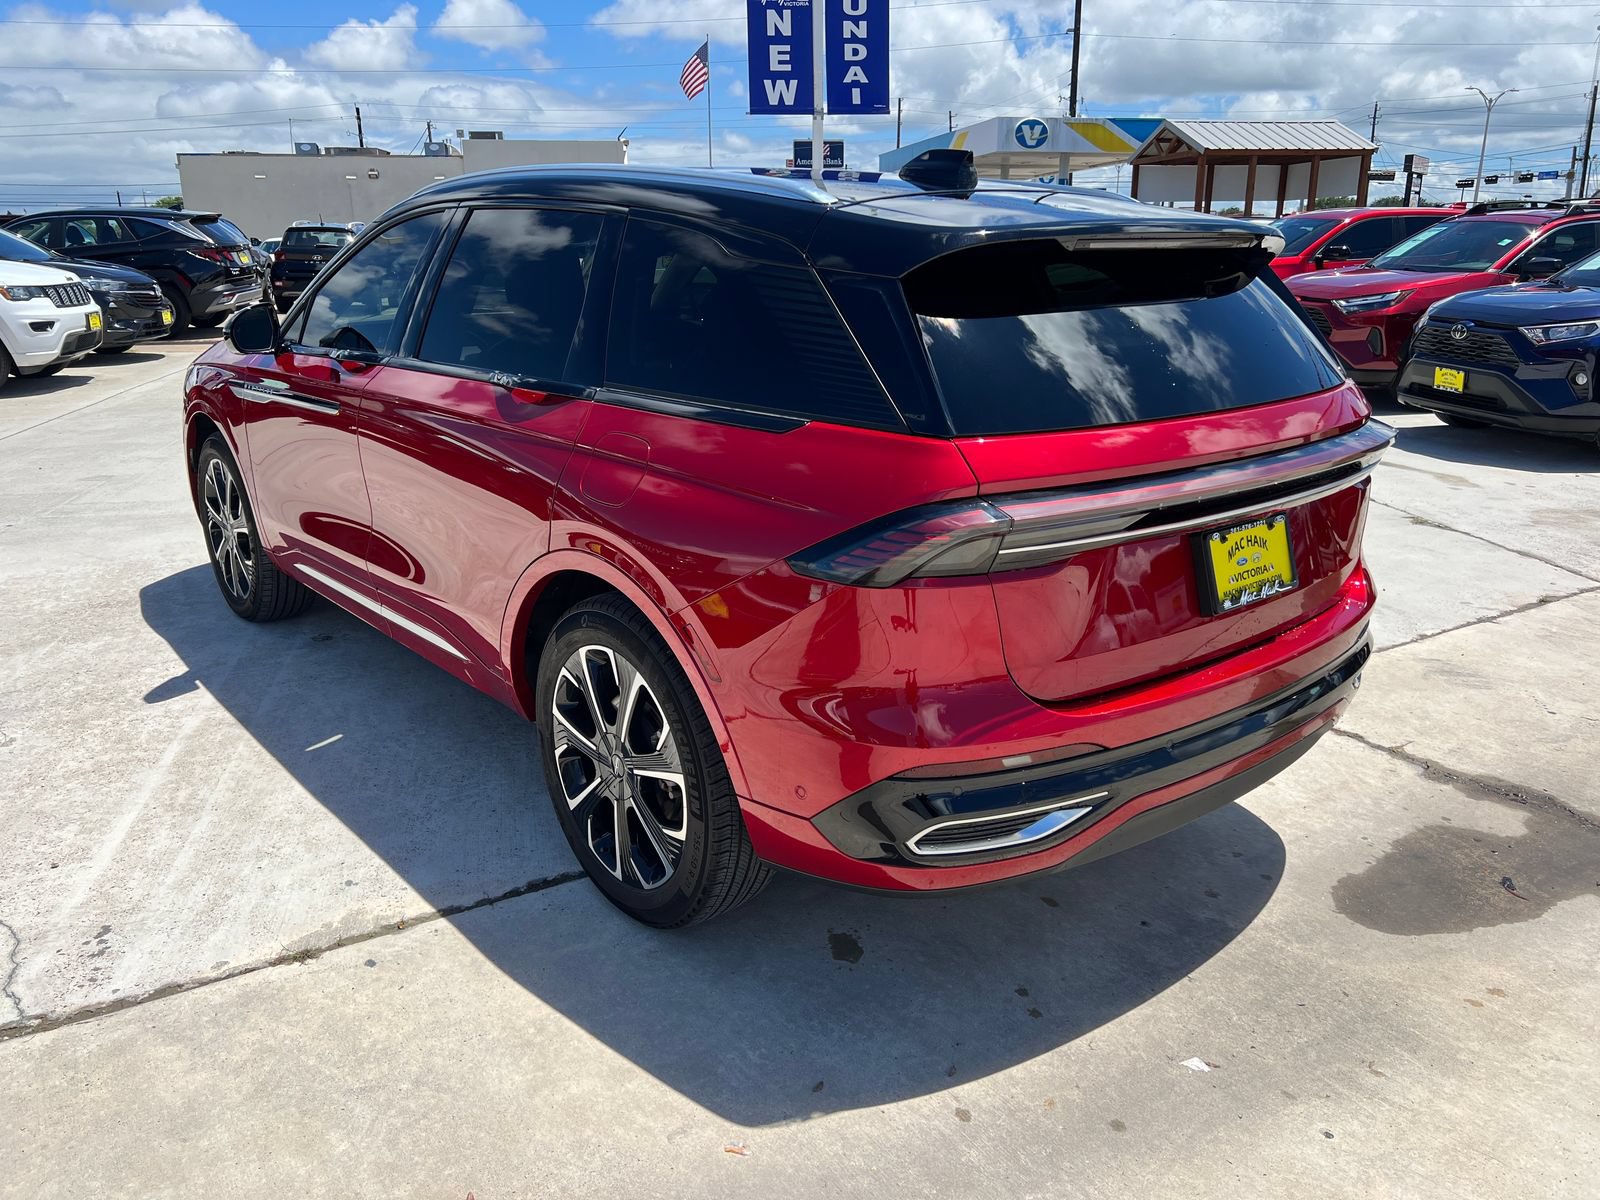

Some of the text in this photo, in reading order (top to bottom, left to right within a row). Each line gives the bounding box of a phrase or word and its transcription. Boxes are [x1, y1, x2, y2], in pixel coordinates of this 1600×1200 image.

[763, 9, 798, 106] NEW
[1227, 536, 1245, 563] MAC
[1246, 535, 1269, 552] HAIK
[1233, 564, 1269, 583] VICTORIA
[1240, 589, 1260, 606] Mac
[664, 702, 703, 822] MICHELIN
